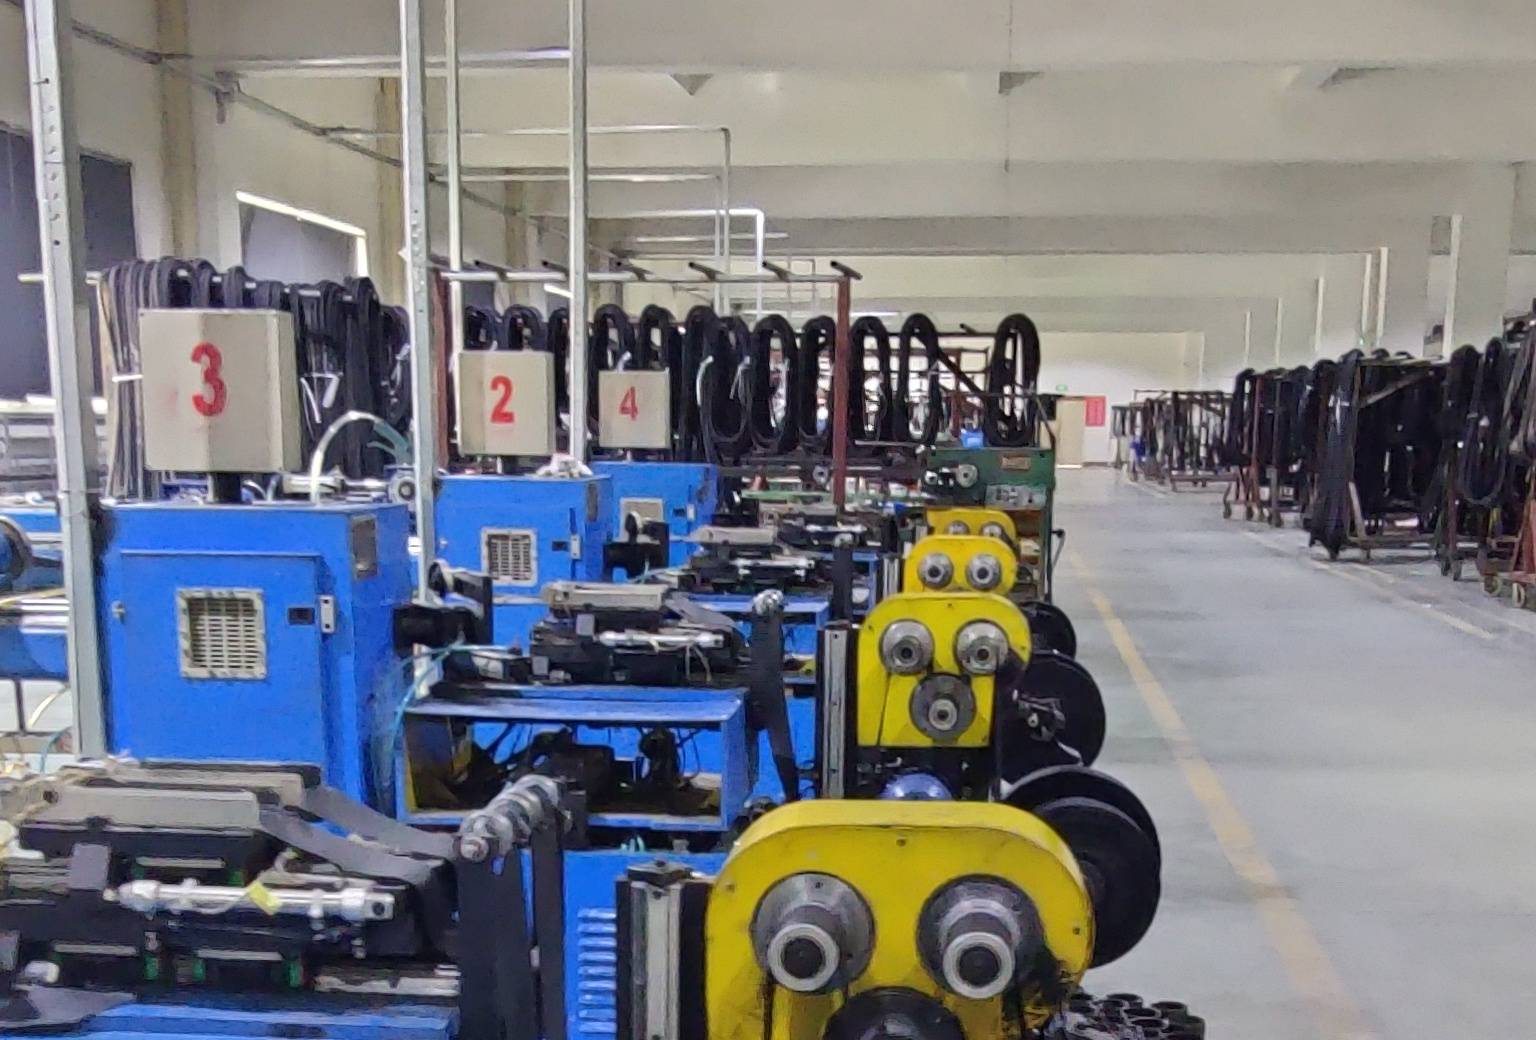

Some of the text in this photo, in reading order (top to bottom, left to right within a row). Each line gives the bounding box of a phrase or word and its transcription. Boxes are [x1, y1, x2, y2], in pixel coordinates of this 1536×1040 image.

[190, 342, 226, 417] 3
[489, 374, 515, 424] 2
[619, 386, 639, 421] 4
